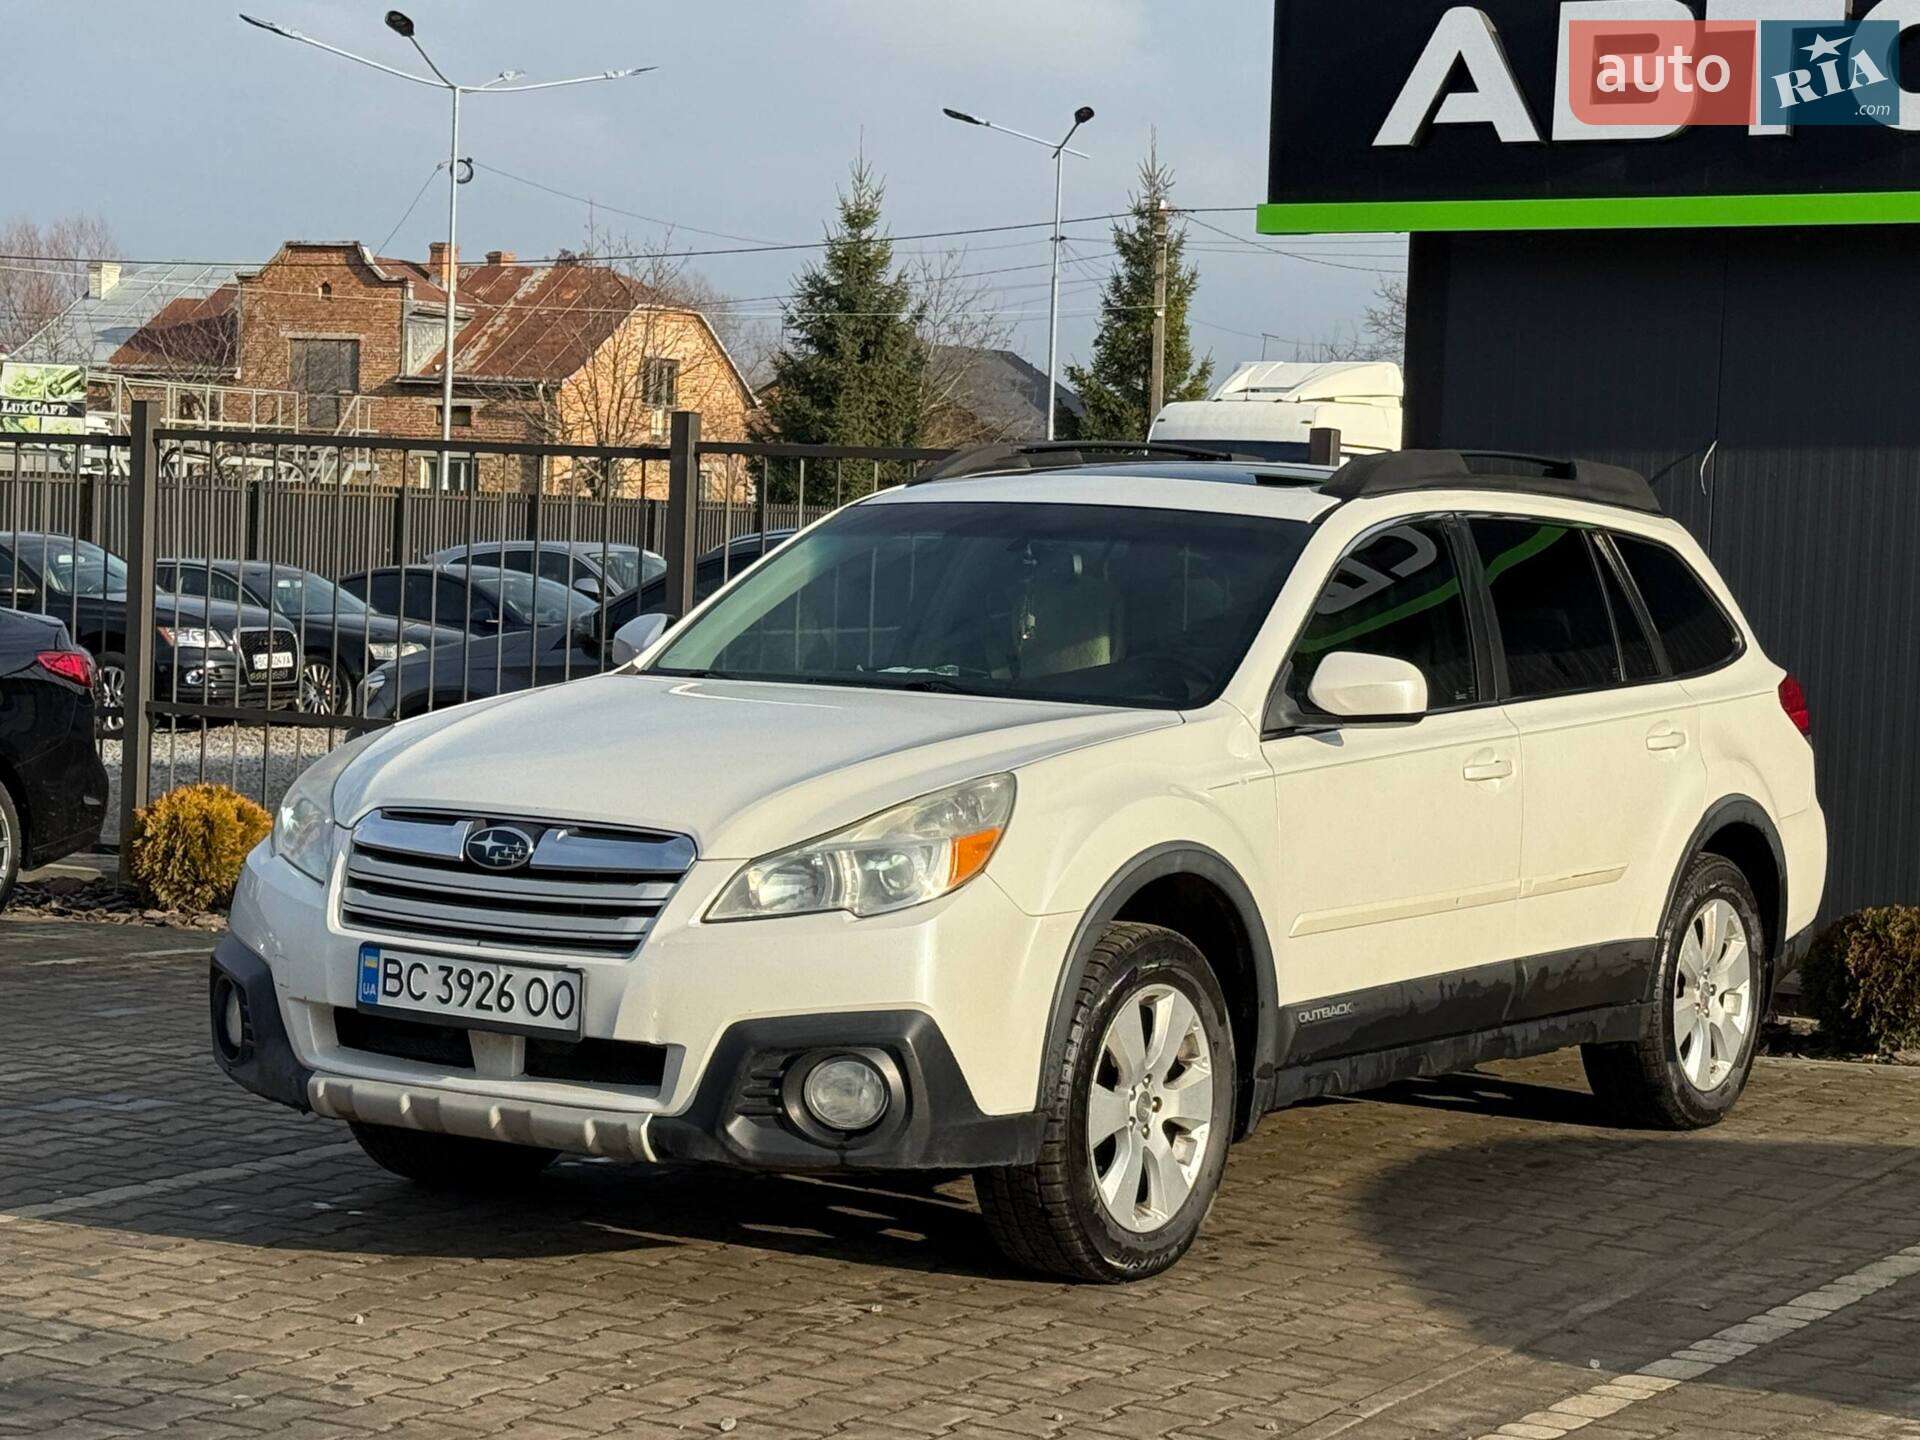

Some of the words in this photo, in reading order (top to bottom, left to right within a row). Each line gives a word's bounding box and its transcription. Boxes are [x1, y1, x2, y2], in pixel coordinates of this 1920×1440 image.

[362, 984, 376, 996] UA
[382, 958, 428, 1001] BC
[435, 965, 515, 1013] 3926
[1298, 1002, 1352, 1023] OUTBACK
